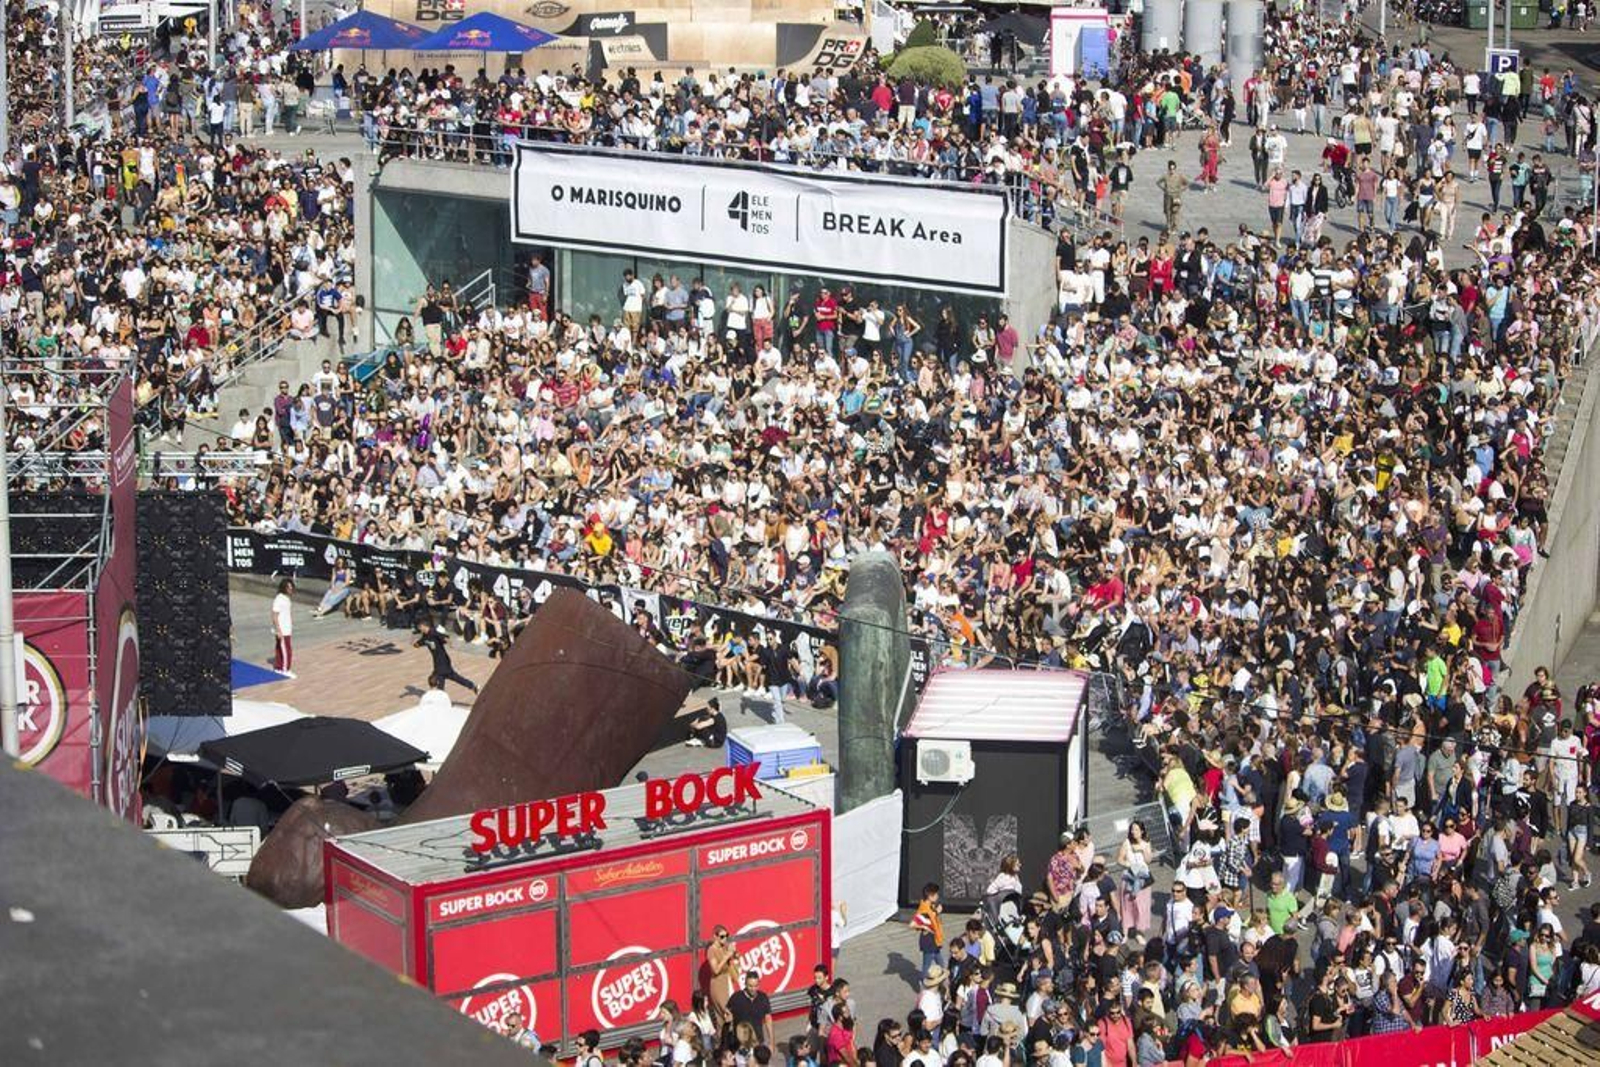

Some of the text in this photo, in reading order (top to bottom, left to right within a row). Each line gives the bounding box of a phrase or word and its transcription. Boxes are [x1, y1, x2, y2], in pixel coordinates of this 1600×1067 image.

[812, 51, 855, 68] DG
[1499, 56, 1511, 72] P
[551, 185, 682, 213] O MARISQUINO
[727, 190, 749, 232] 4
[751, 195, 769, 206] ELE
[751, 210, 773, 221] MEN
[751, 223, 770, 234] TOS
[823, 212, 962, 244] BREAK Area
[233, 537, 251, 547] ELE
[233, 548, 255, 557] MEN
[470, 761, 763, 853] SUPER BOCK
[707, 845, 748, 865] SUPER
[749, 837, 786, 857] BOCK
[440, 895, 484, 916] SUPER
[485, 887, 524, 907] BOCK
[600, 962, 656, 1005] SUPER
[469, 989, 523, 1025] UPER
[608, 977, 659, 1019] BOCK
